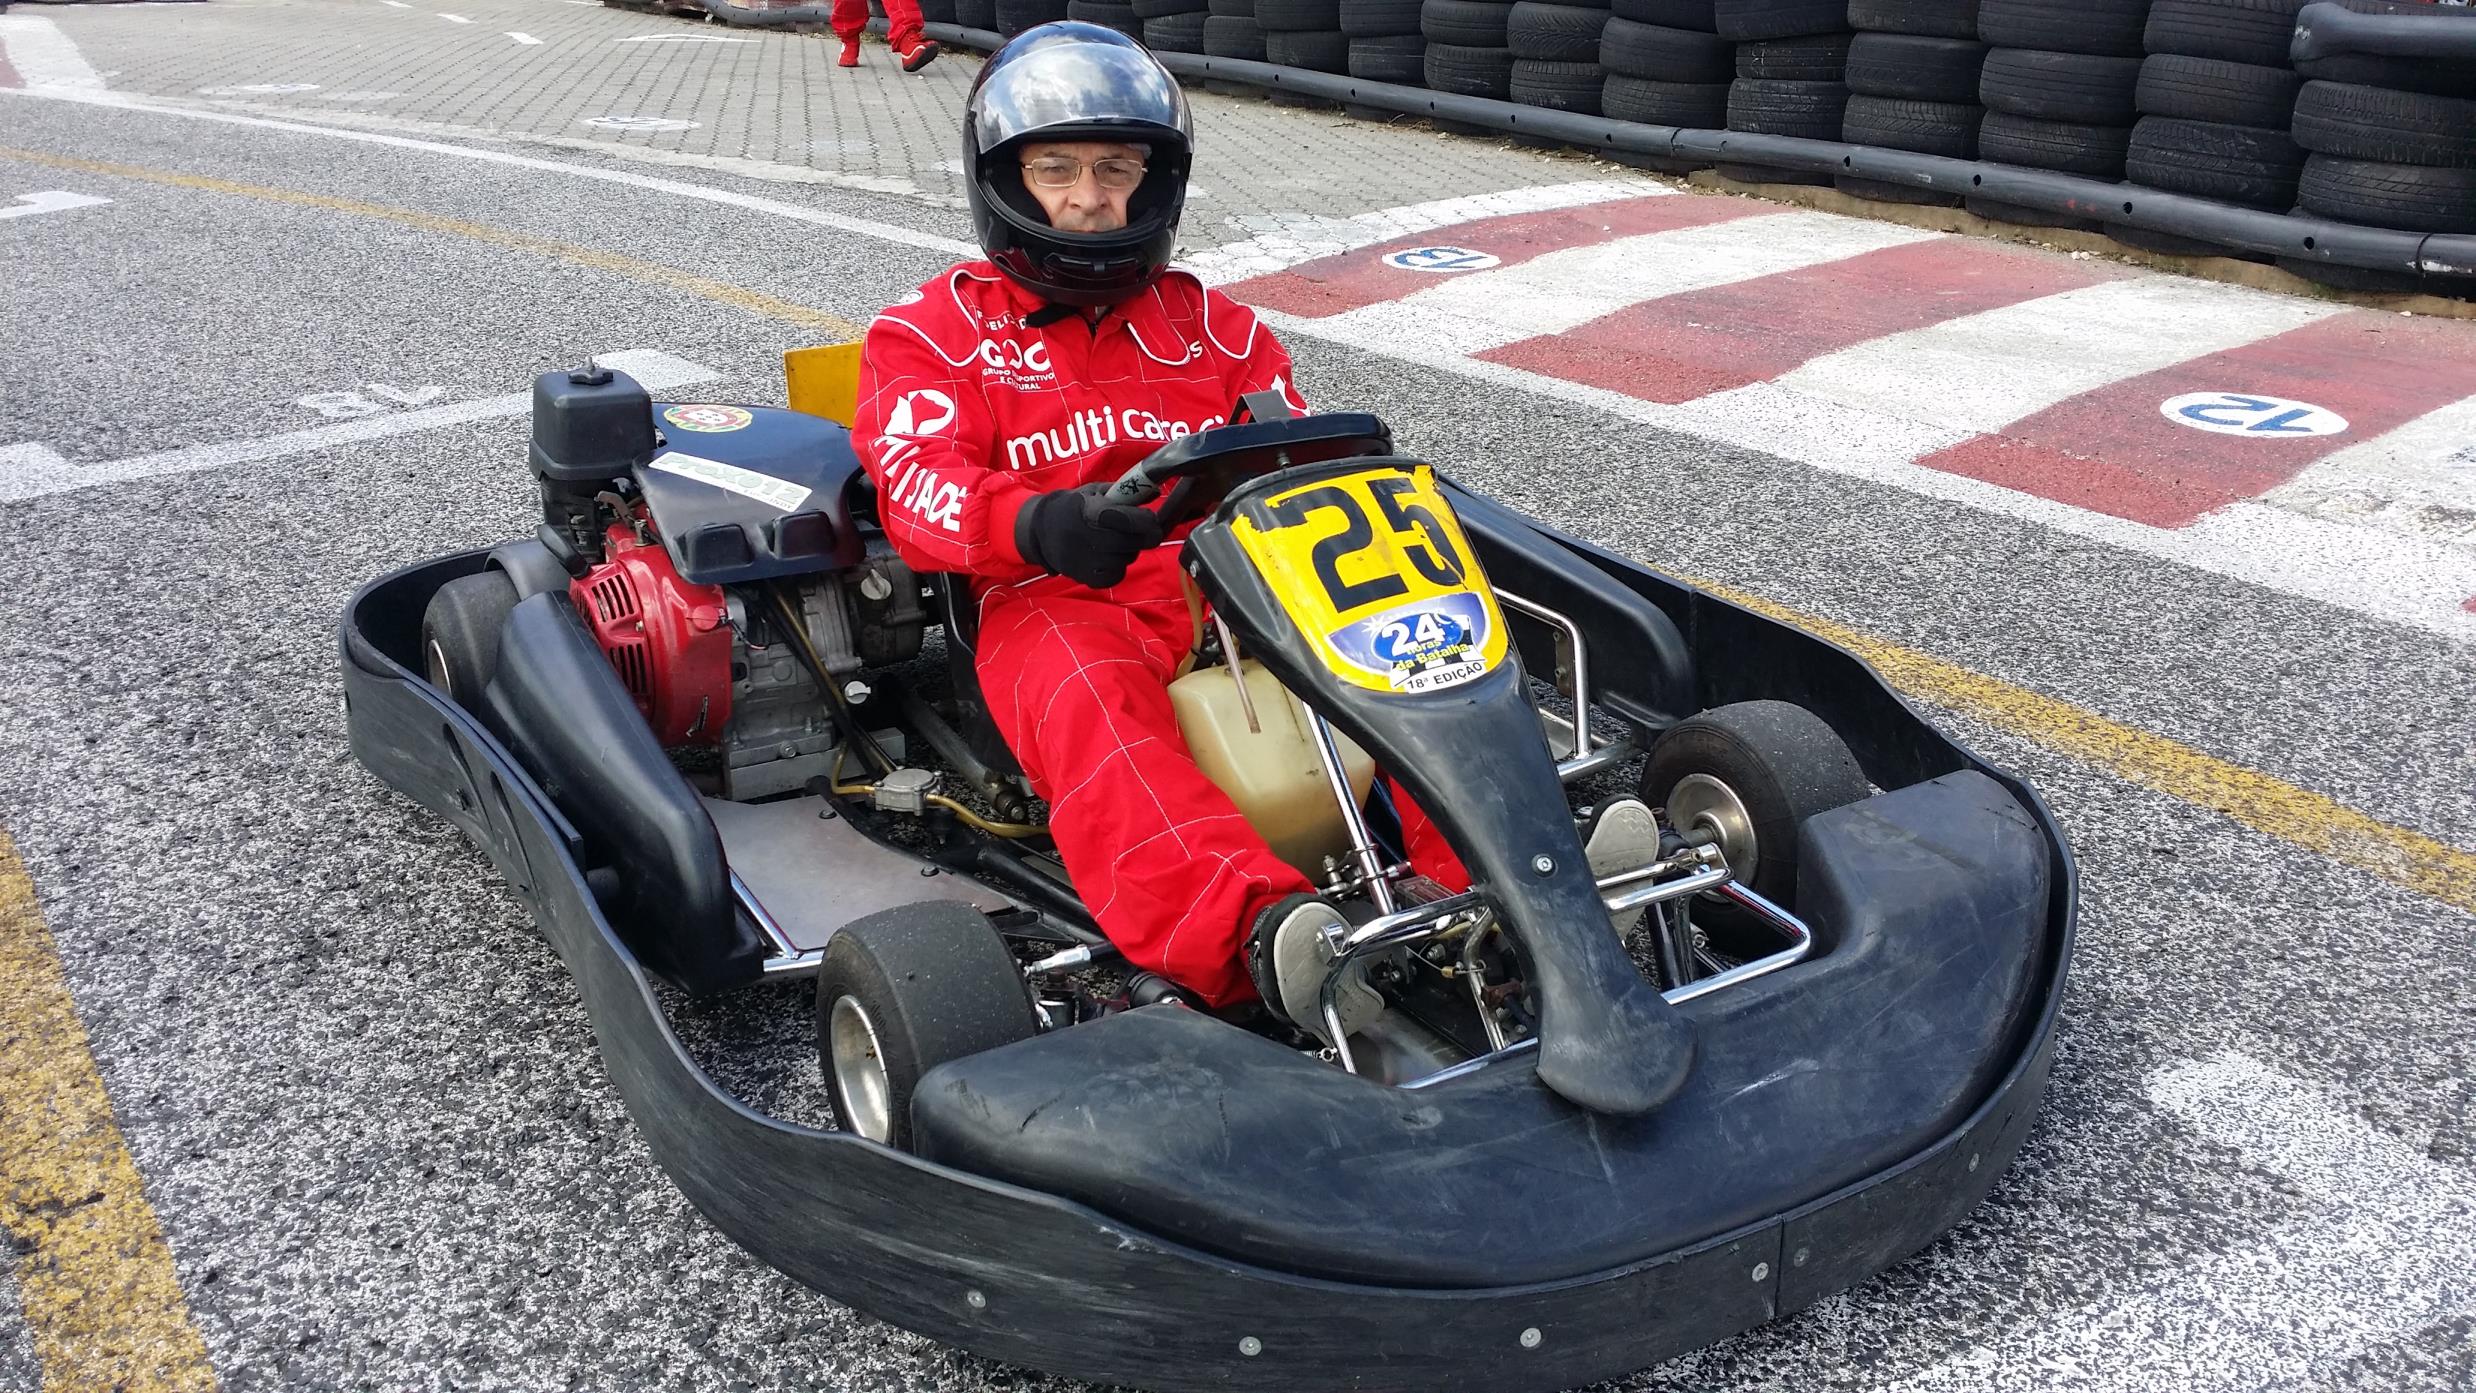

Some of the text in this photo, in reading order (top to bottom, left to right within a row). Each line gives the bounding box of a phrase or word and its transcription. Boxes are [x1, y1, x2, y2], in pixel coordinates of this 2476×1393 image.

[982, 367, 1056, 383] GRUPO PORTIVO
[2178, 395, 2314, 433] 12
[1006, 405, 1190, 470] multi care
[1276, 477, 1466, 614] 25
[1381, 613, 1446, 657] 24
[1395, 643, 1471, 672] da Batalha
[1433, 662, 1483, 685] EDIÇÃO
